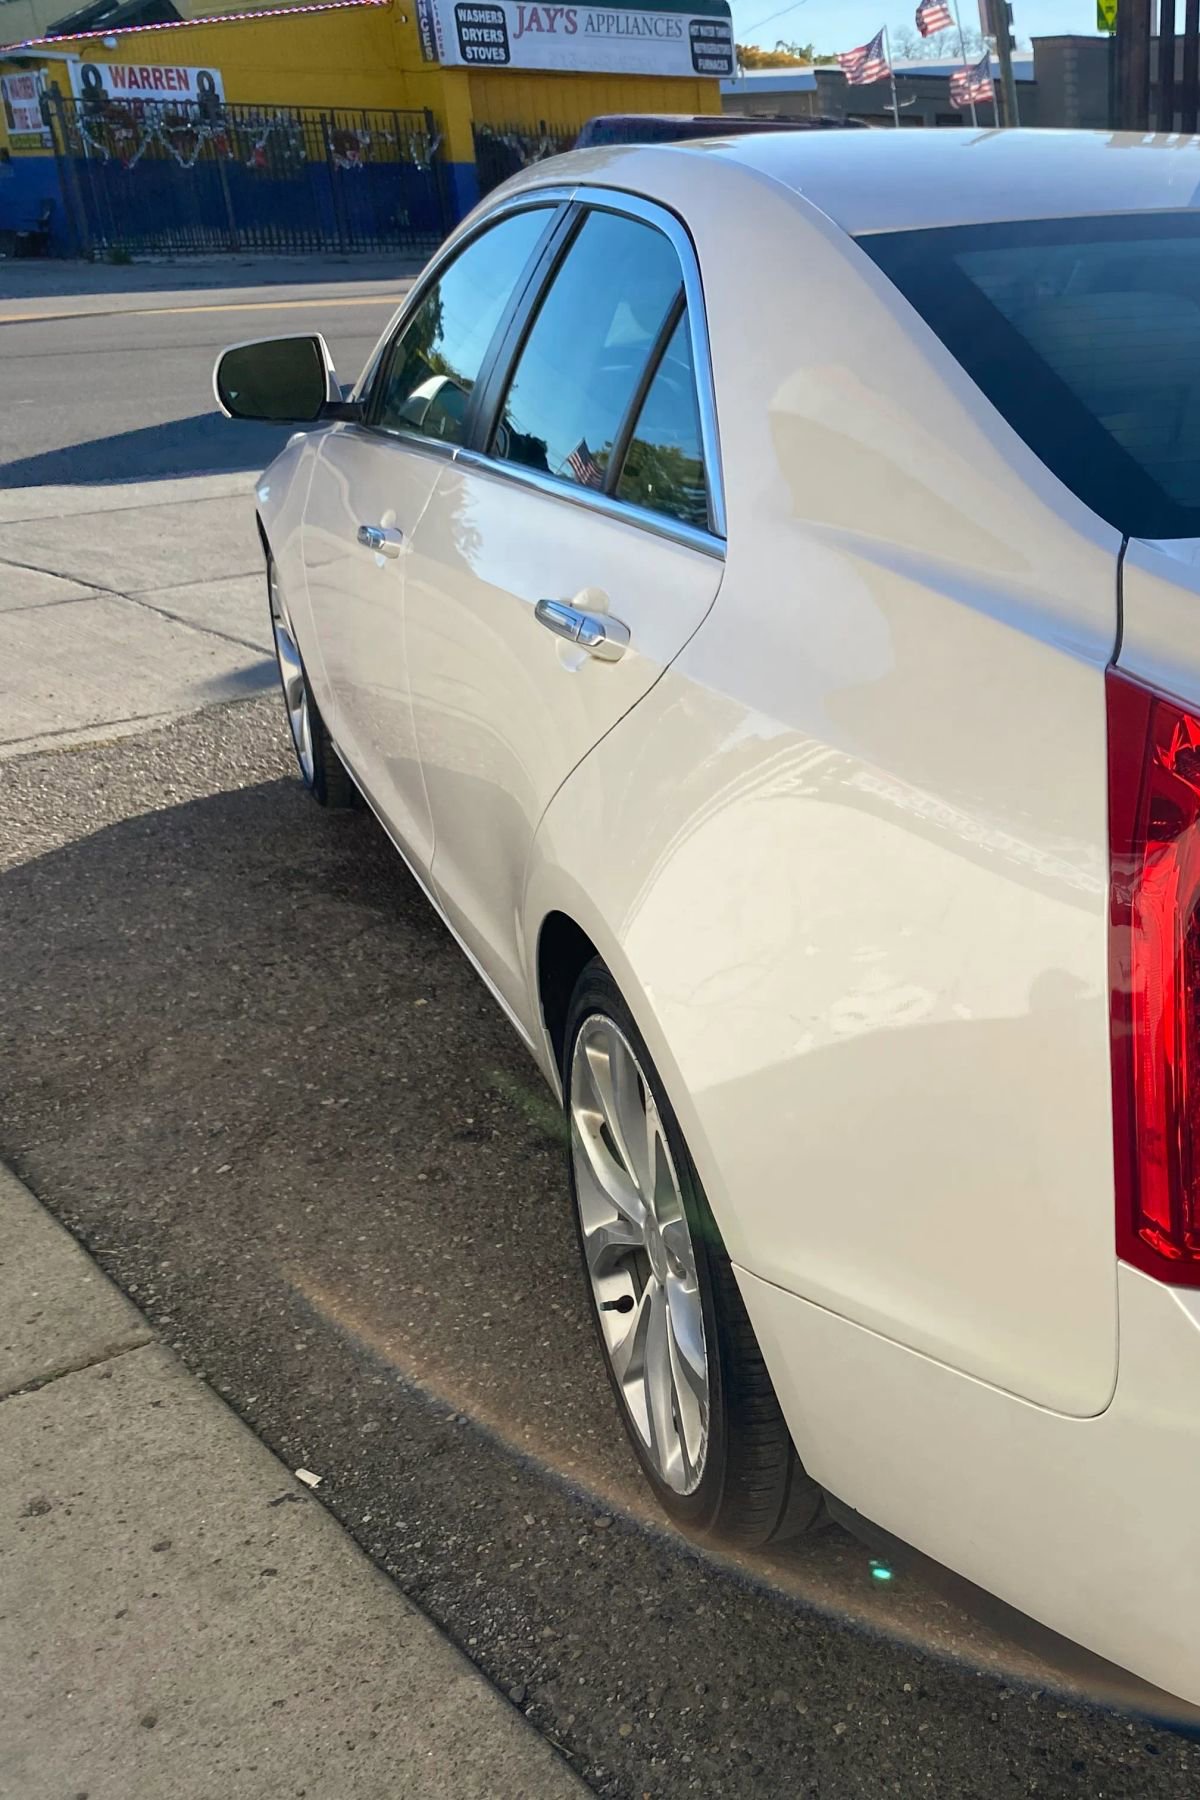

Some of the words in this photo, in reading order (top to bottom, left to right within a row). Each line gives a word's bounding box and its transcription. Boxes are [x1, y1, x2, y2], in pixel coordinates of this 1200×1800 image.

[457, 9, 503, 24] WASHERS
[512, 5, 579, 39] JAY'S
[584, 13, 683, 38] APPLIANCES
[461, 28, 504, 43] DRYERS
[465, 46, 506, 61] STOVES
[108, 65, 191, 91] WARREN
